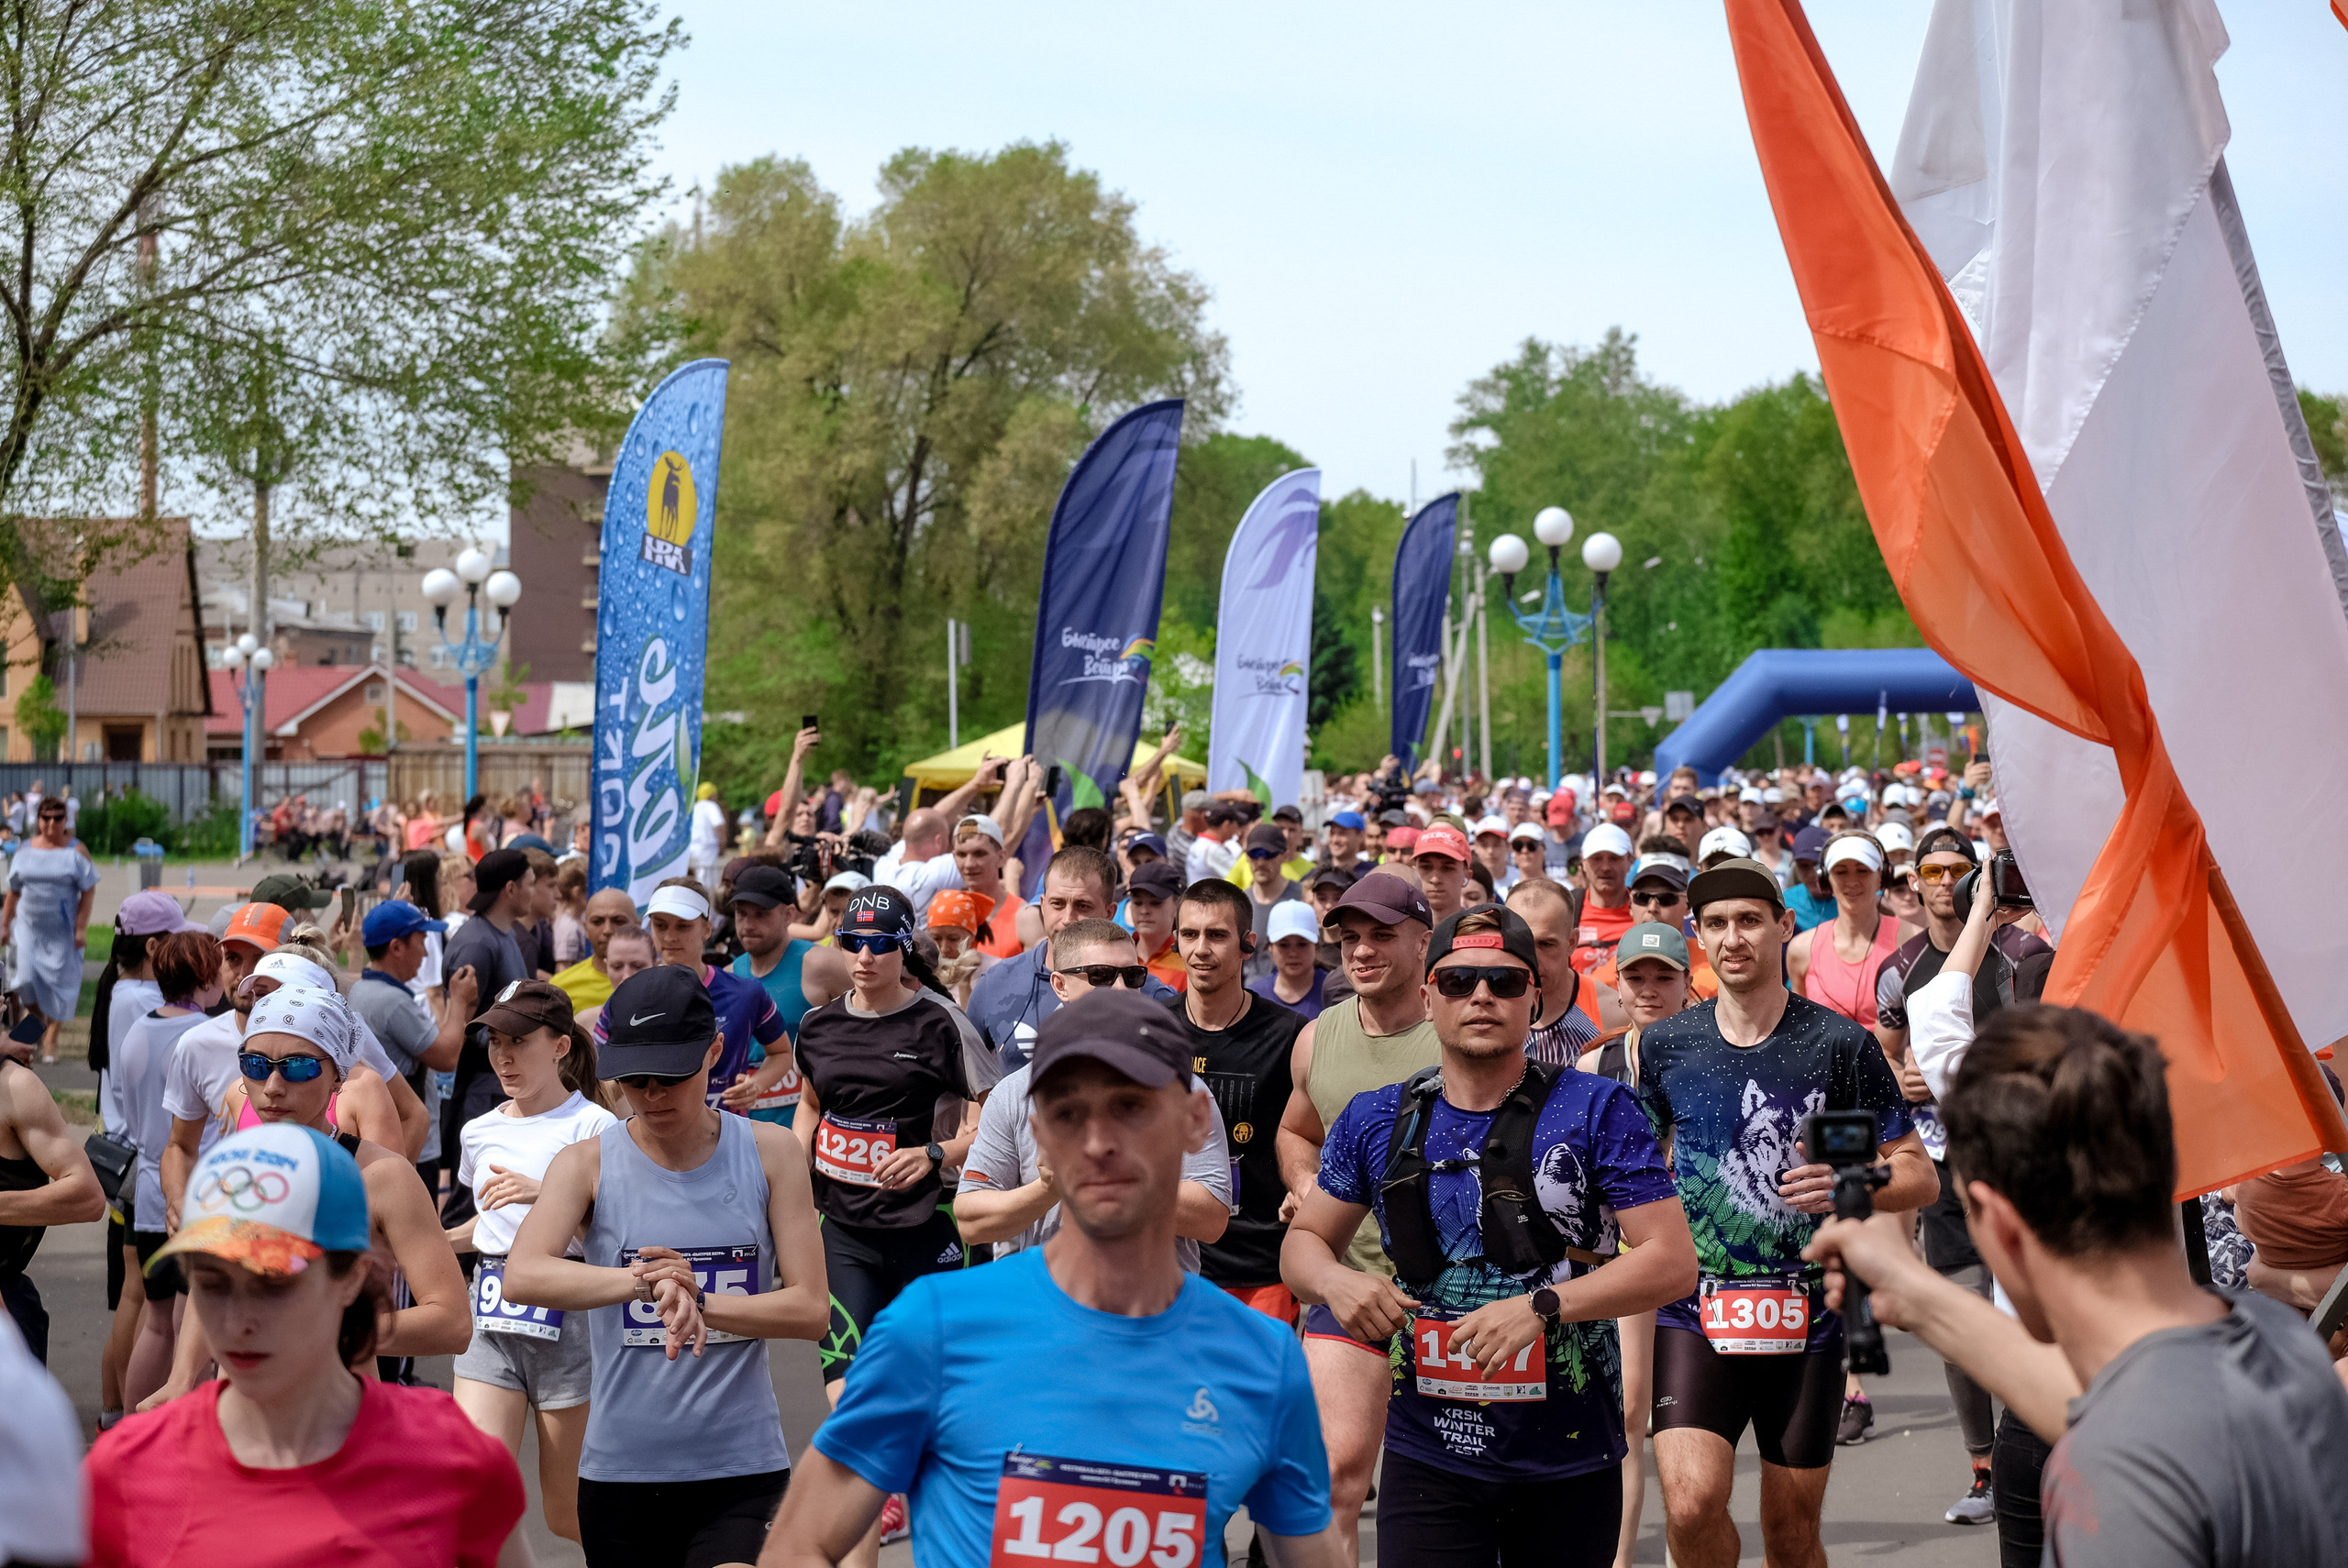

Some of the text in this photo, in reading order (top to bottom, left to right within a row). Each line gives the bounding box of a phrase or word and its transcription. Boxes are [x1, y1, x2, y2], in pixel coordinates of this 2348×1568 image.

[848, 892, 890, 912] DNB
[1191, 1056, 1207, 1073] ACE
[819, 1128, 891, 1165] 1226
[937, 1252, 963, 1264] adidas
[1706, 1297, 1805, 1330] 1305
[1422, 1330, 1536, 1372] 147
[1441, 1408, 1483, 1423] KRSK
[1434, 1416, 1496, 1437] WINTER
[1440, 1430, 1487, 1449] TRAIL
[1445, 1443, 1484, 1457] FEST
[1003, 1496, 1196, 1568] 1205
